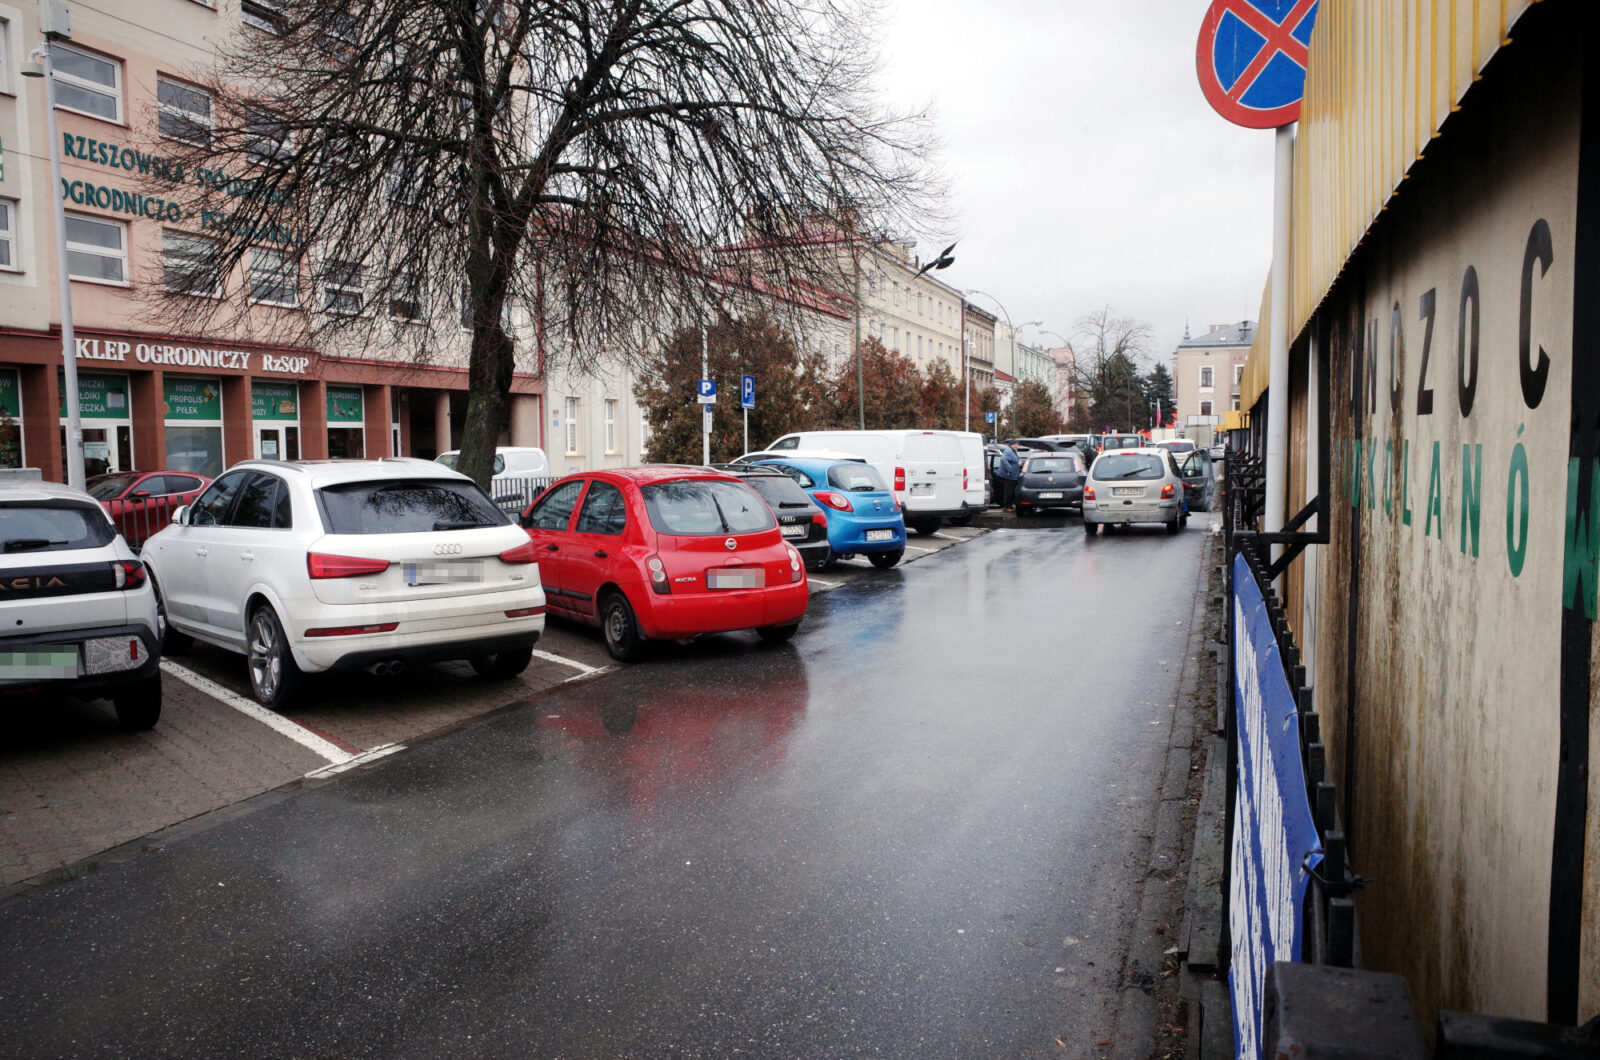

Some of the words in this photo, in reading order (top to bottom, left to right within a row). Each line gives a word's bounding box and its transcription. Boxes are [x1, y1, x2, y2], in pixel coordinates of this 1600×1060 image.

[63, 132, 185, 184] RZESZOWSKA
[63, 338, 131, 362] KLEP
[135, 343, 251, 370] OGRODNICZY
[262, 354, 310, 374] RzSOP
[78, 379, 104, 389] NICZKI
[702, 381, 712, 394] P
[745, 378, 753, 398] P
[79, 391, 100, 400] ŁOIKI
[169, 394, 203, 403] PROPOLIS
[80, 403, 105, 412] ECZKA
[176, 406, 198, 414] PYŁEK
